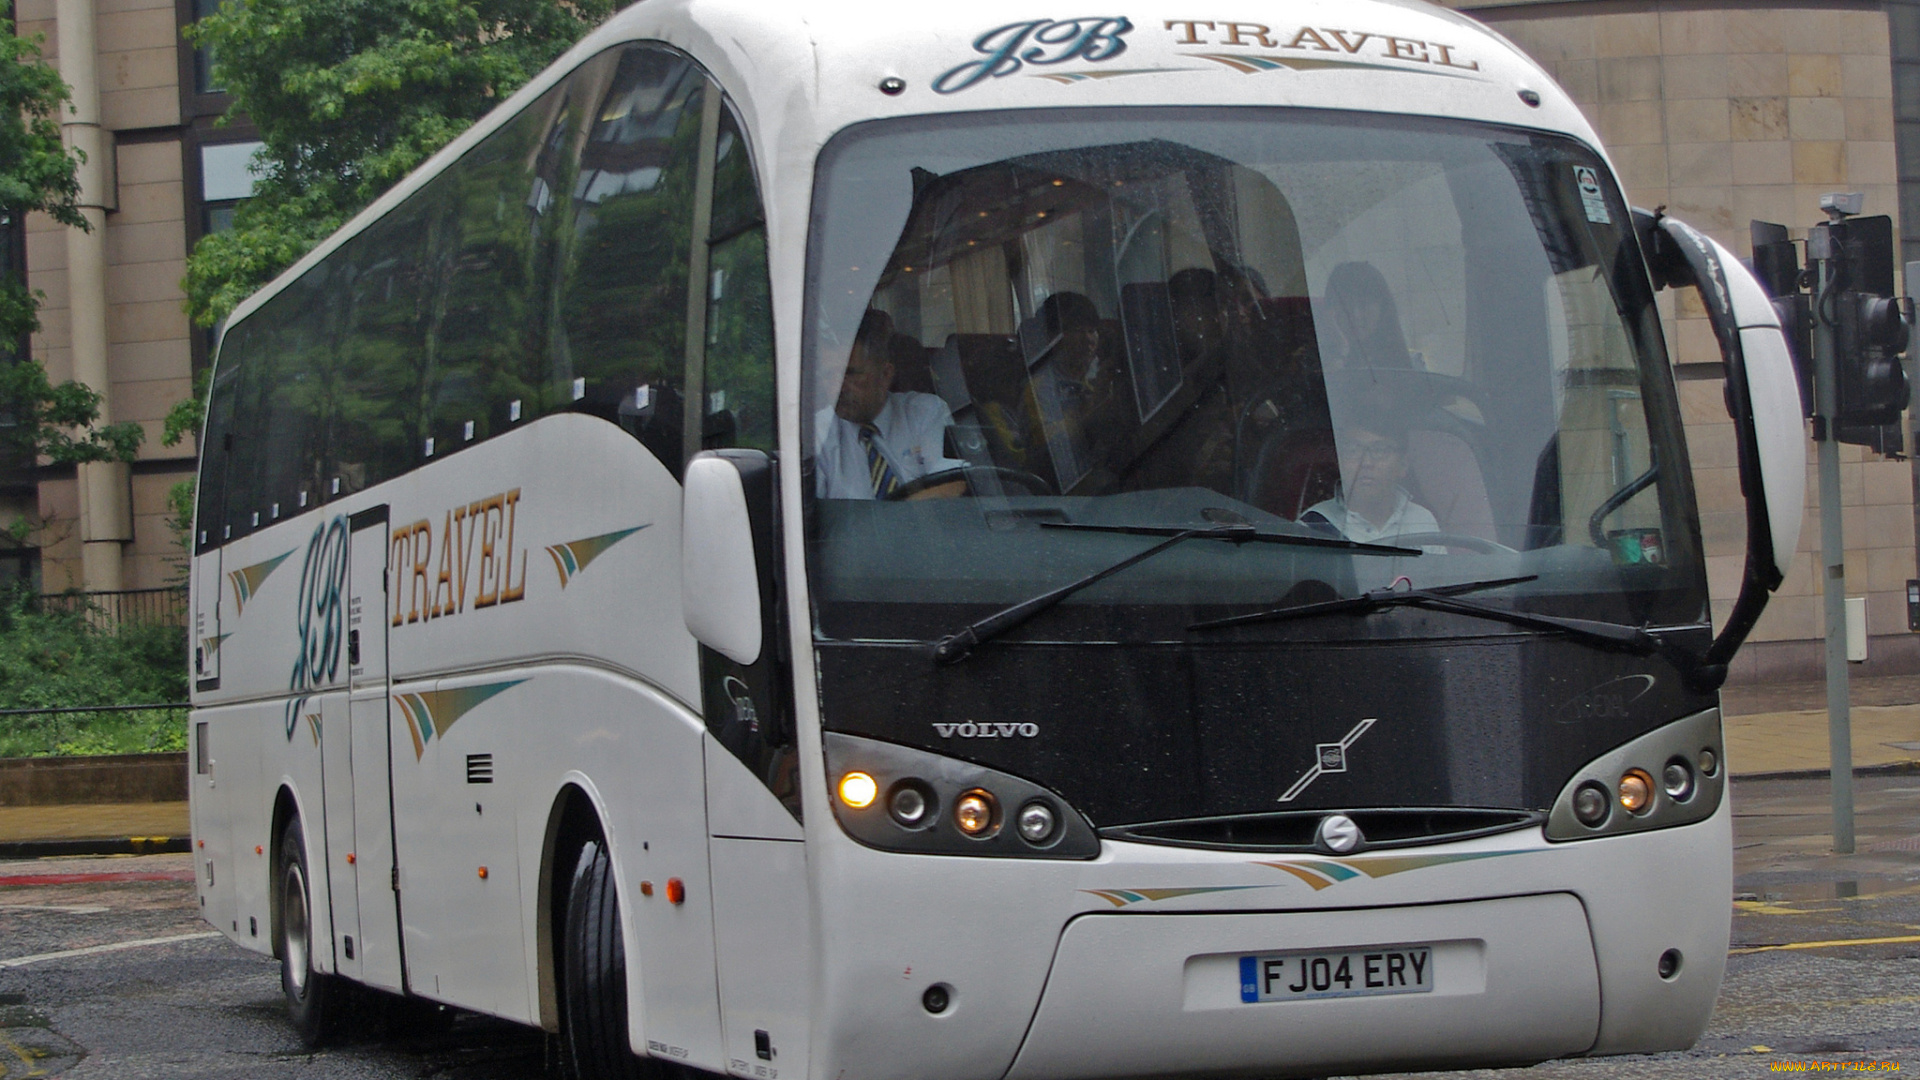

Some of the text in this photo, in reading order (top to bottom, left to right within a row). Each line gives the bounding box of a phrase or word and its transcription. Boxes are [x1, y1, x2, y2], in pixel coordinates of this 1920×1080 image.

[931, 16, 1480, 95] JB TRAVEL
[286, 487, 528, 742] JB TRAVEL
[932, 719, 1040, 738] VOLVO
[1263, 951, 1428, 994] FJ04 ERY
